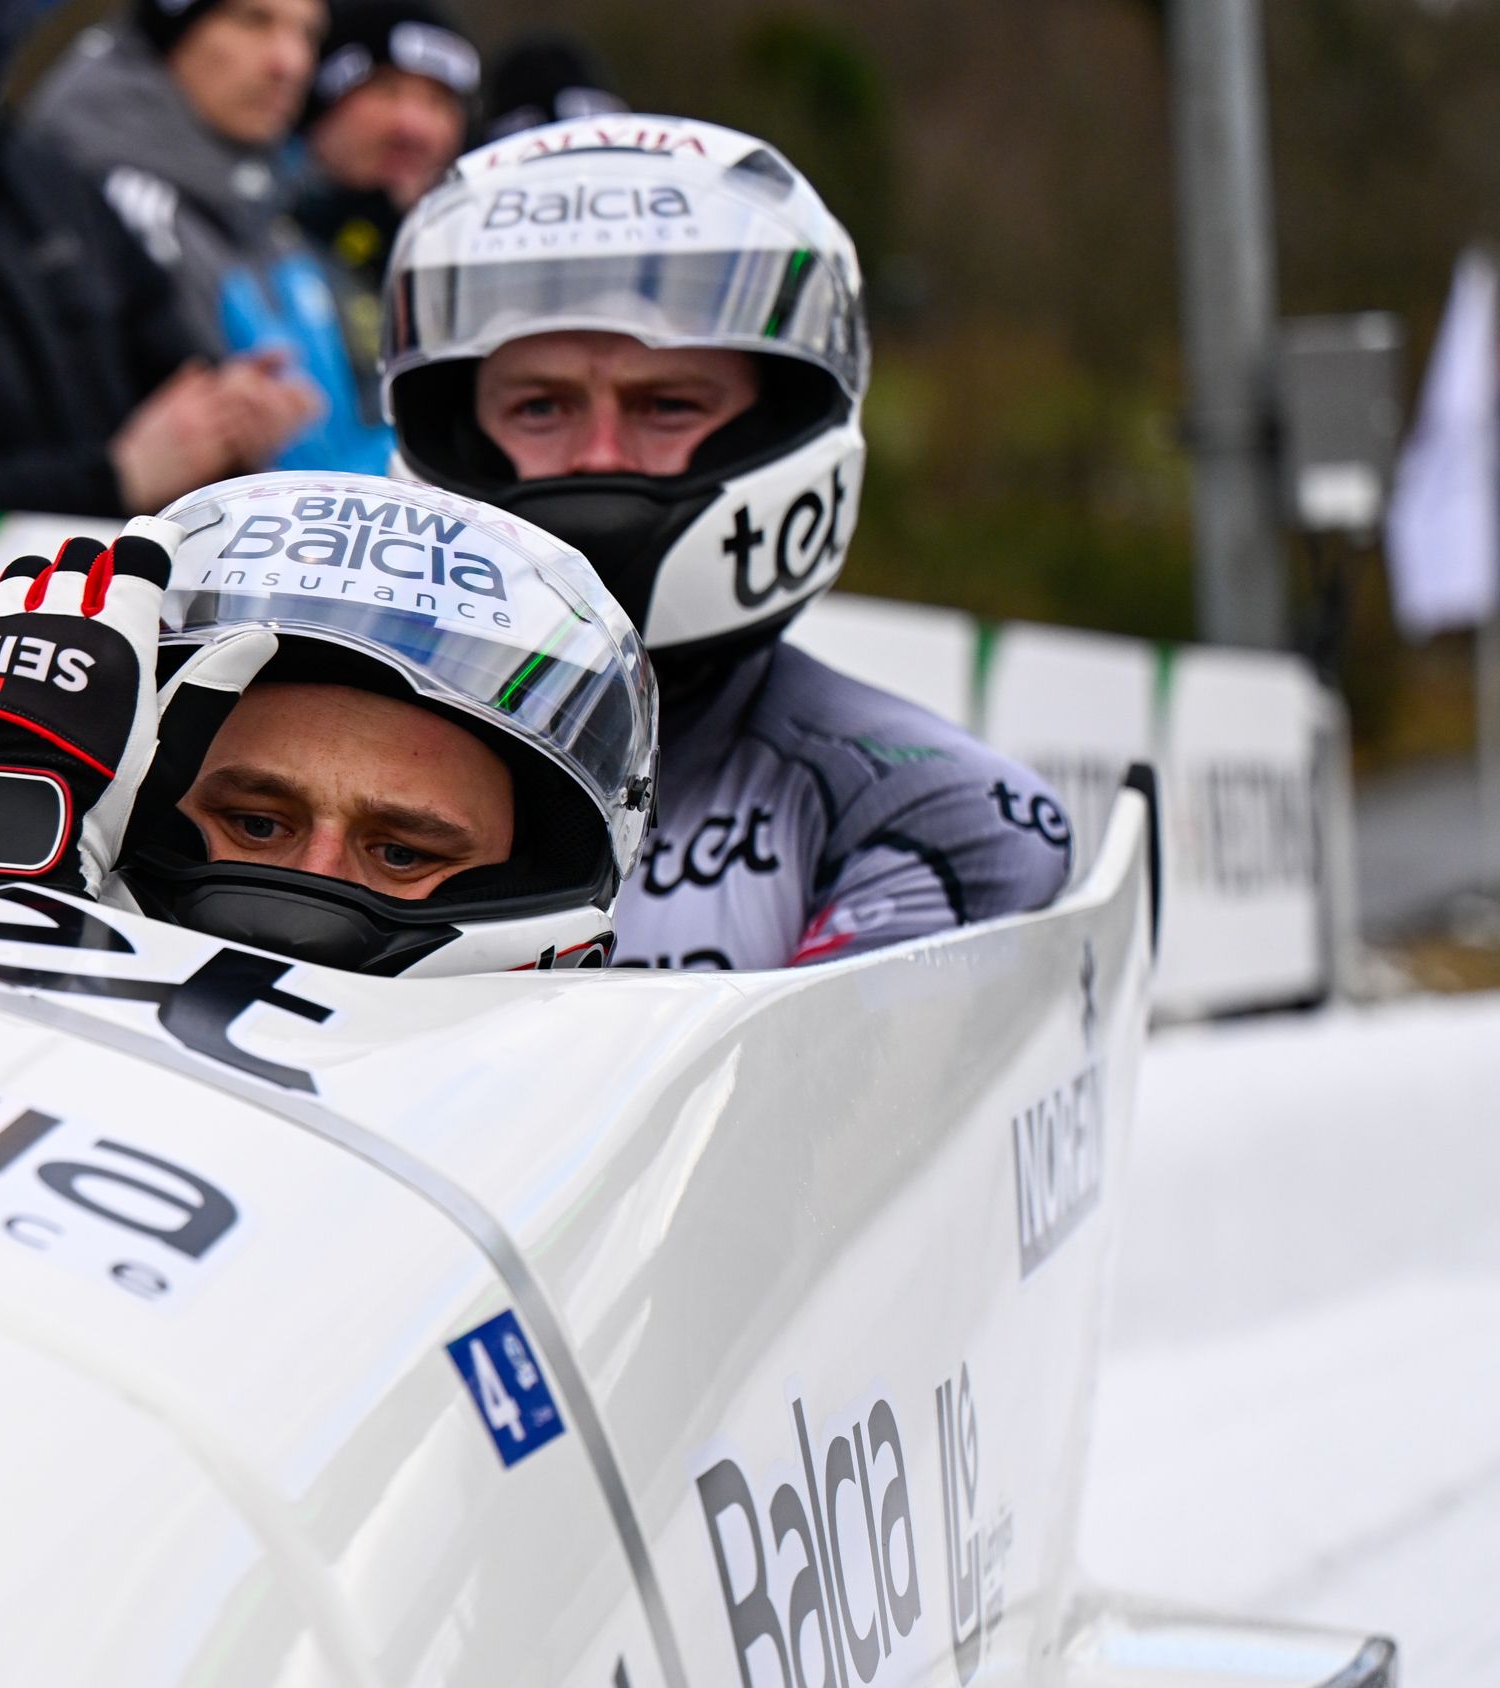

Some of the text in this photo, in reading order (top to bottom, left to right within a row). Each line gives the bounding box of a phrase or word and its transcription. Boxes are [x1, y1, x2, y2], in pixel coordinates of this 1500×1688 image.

[483, 183, 693, 230] Balcia
[216, 514, 508, 602] Balcia
[291, 496, 468, 546] BMW
[722, 462, 847, 610] tet
[200, 569, 512, 629] insurance
[468, 1337, 527, 1443] 4
[695, 1396, 923, 1688] Balcia
